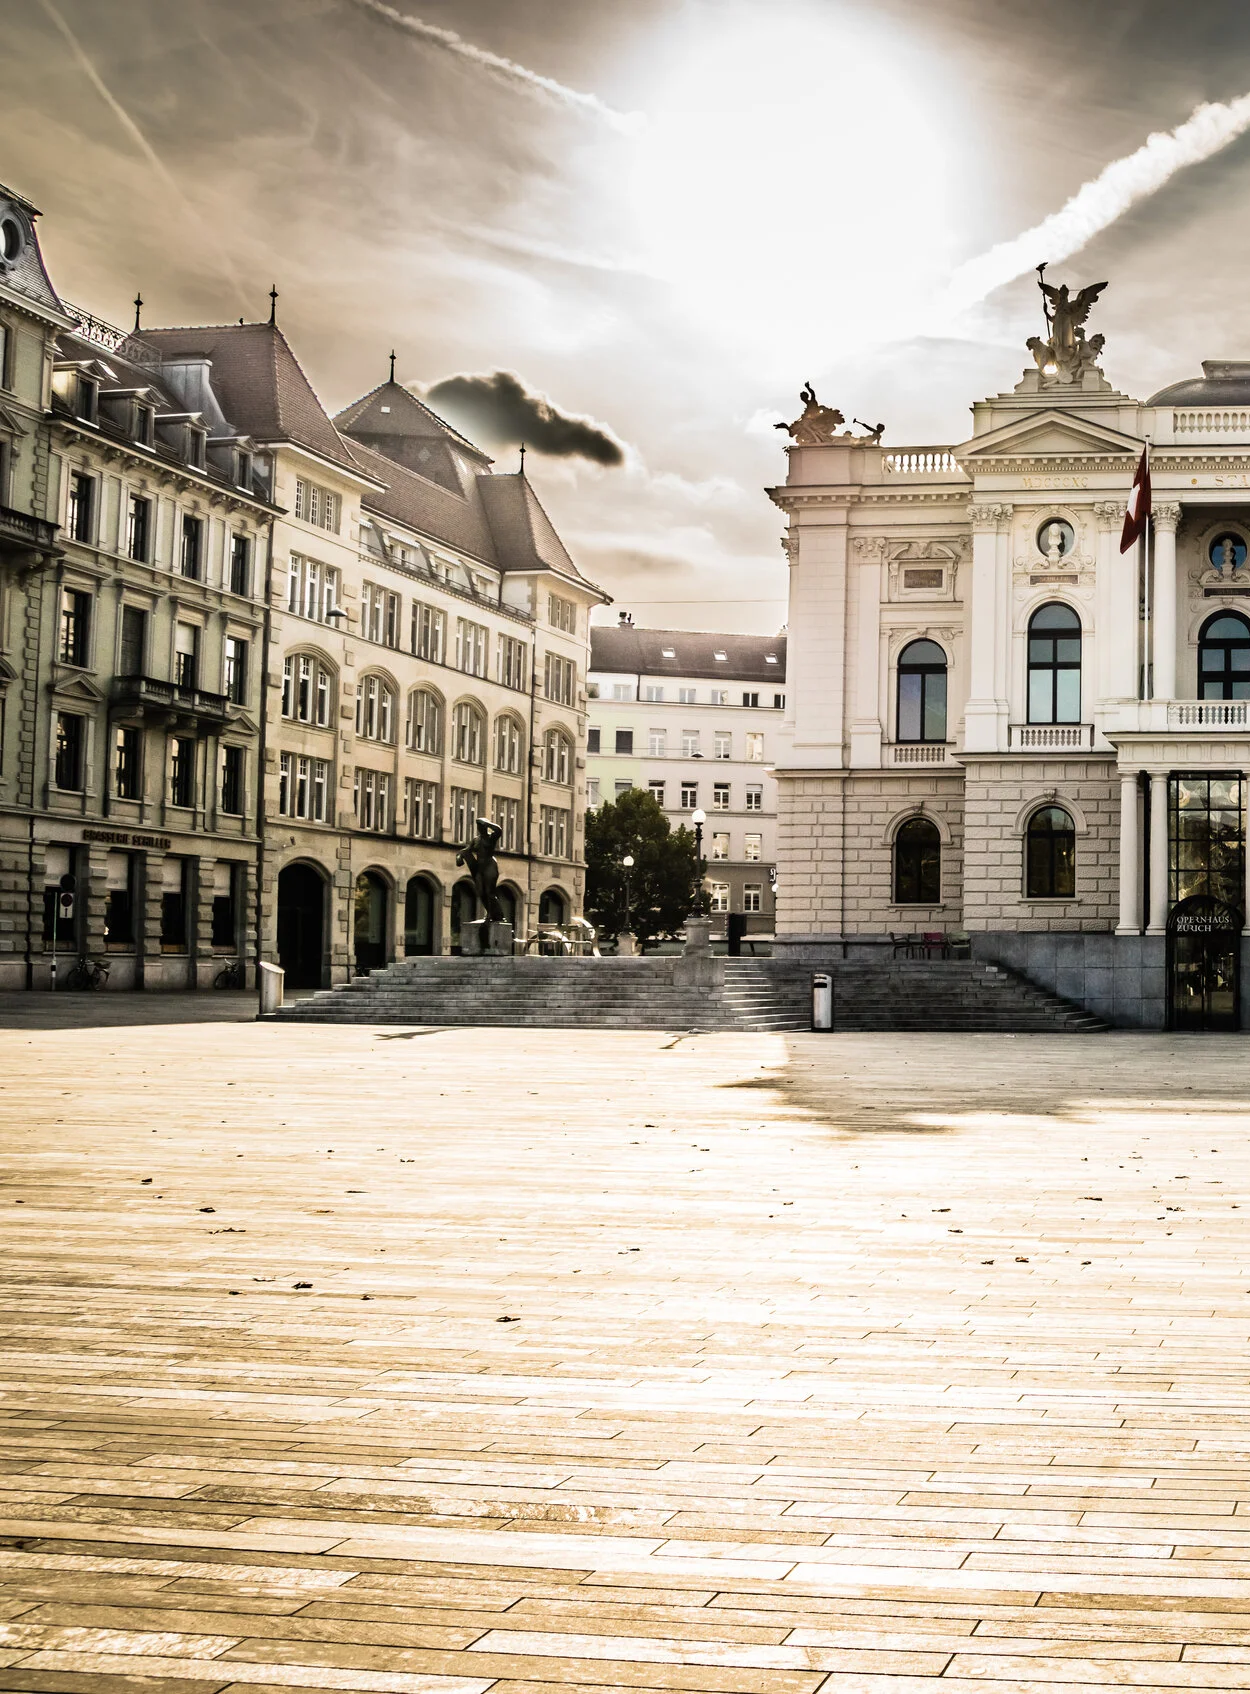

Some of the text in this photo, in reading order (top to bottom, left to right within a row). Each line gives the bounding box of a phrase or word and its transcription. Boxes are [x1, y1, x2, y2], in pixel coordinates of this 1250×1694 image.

[82, 828, 172, 850] BRASSERIE SCHILLER
[1176, 916, 1230, 924] OPERNHAUS
[1176, 924, 1212, 932] ZÜRICH
